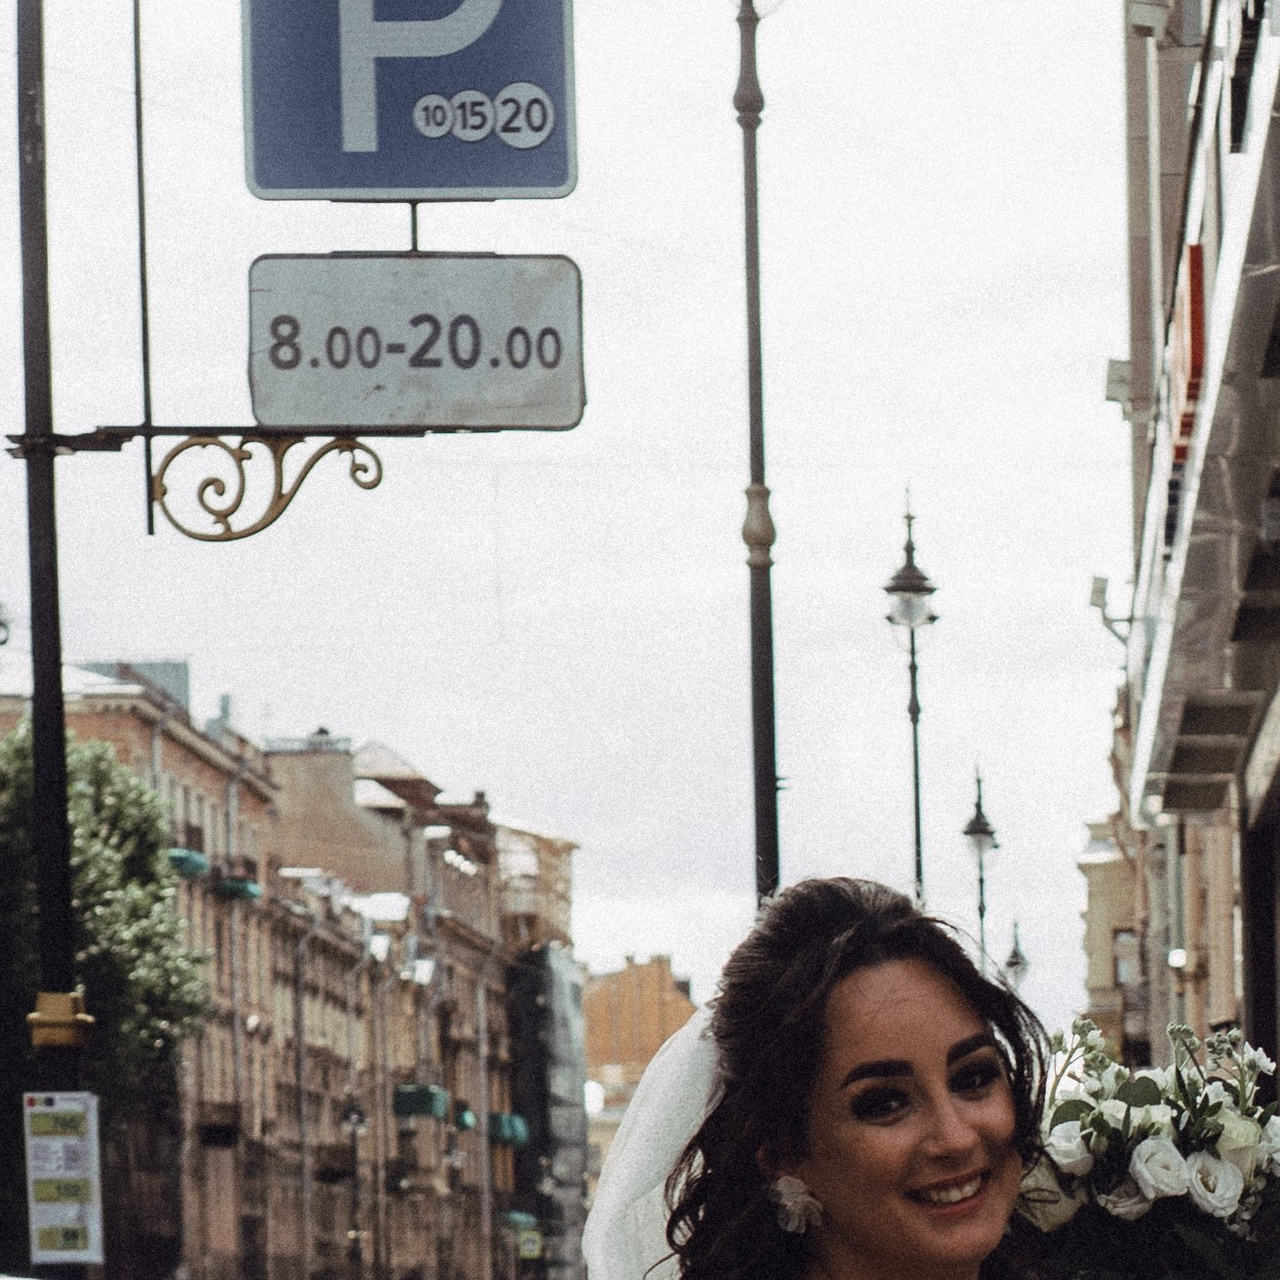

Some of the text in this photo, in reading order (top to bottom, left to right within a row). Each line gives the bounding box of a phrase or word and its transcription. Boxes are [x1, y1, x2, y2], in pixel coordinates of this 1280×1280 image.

[421, 98, 548, 133] 10 15 20
[269, 314, 563, 369] 8.00-20.00
